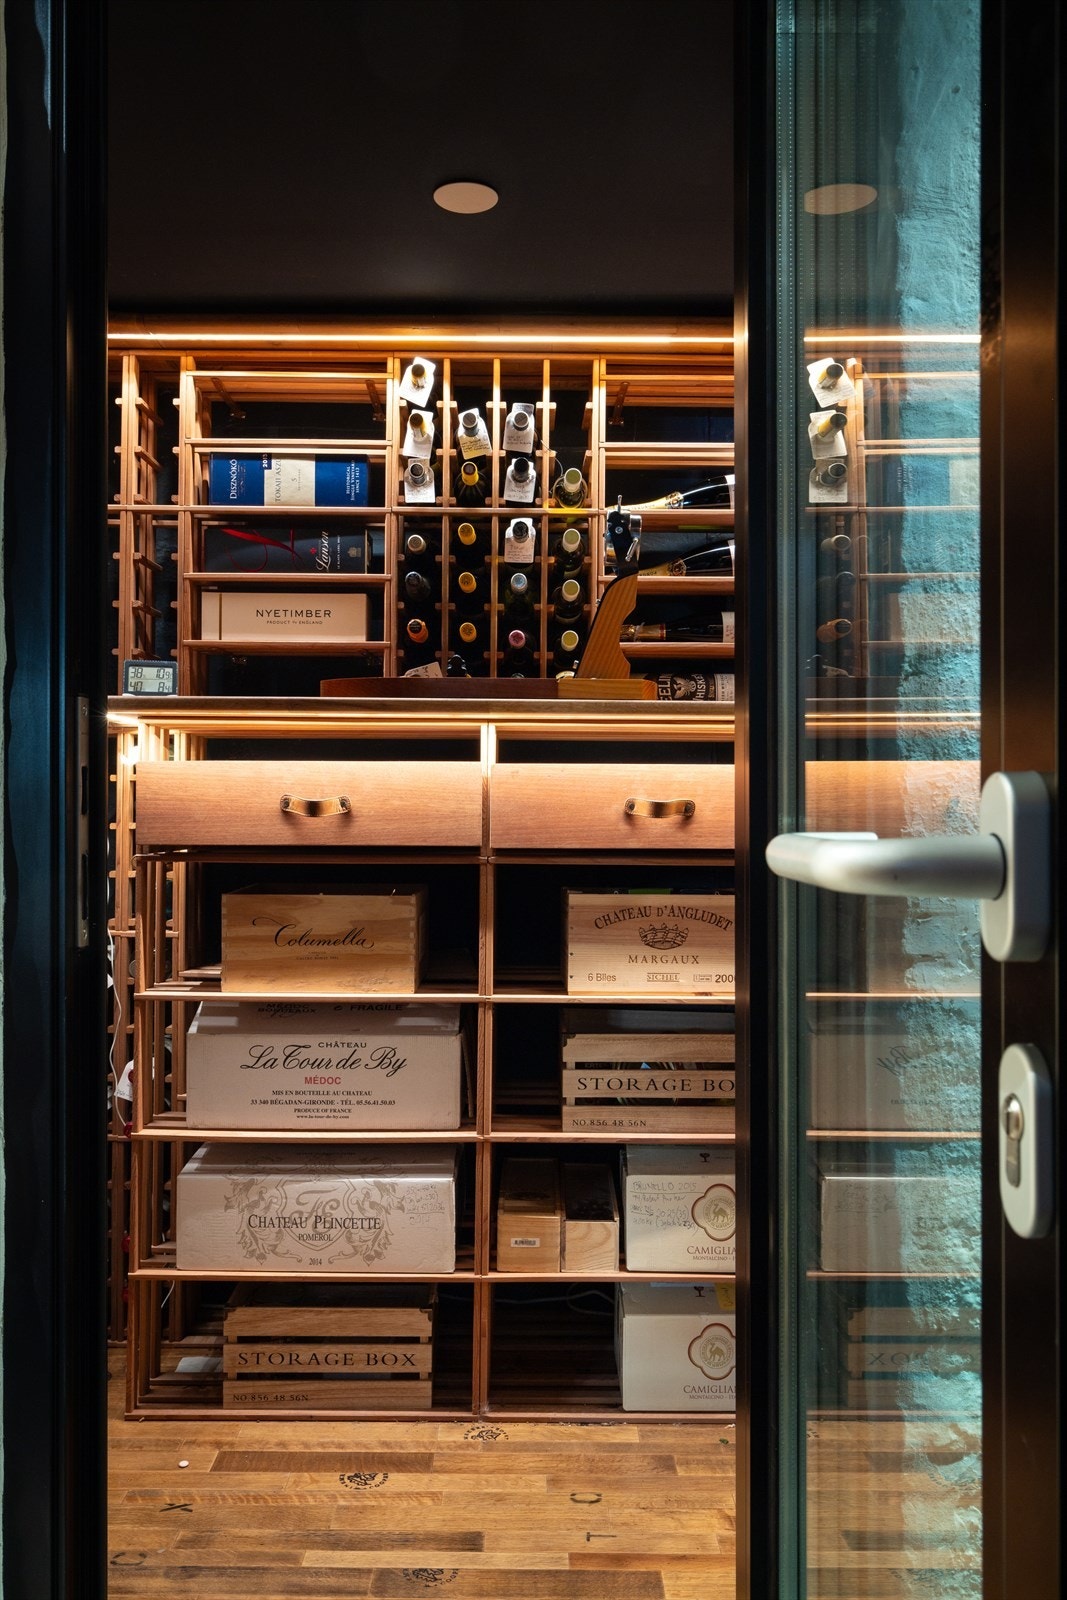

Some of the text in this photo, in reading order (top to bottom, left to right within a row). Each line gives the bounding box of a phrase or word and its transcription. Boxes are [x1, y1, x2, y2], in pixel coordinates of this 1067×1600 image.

[274, 478, 282, 503] TOKAJI
[315, 530, 331, 572] Lanson
[256, 609, 332, 618] NYETIMBER
[594, 904, 651, 930] CHATEAU
[274, 923, 375, 949] Columella
[628, 954, 700, 965] MARGAUX
[587, 973, 594, 982] 6
[318, 1041, 367, 1049] CHÂTEAU
[240, 1044, 408, 1078] La Tour de By
[304, 1074, 342, 1085] MÉDOC
[577, 1077, 735, 1092] STORAGE BO
[612, 1119, 624, 1127] 48
[628, 1119, 647, 1127] 56N
[248, 1214, 381, 1230] CHATEAU PLINCETTE
[298, 1233, 332, 1241] POMEROL
[308, 1257, 322, 1266] 2014
[238, 1352, 416, 1367] STORAGE BOX
[683, 1384, 736, 1394] CAMIGLIA
